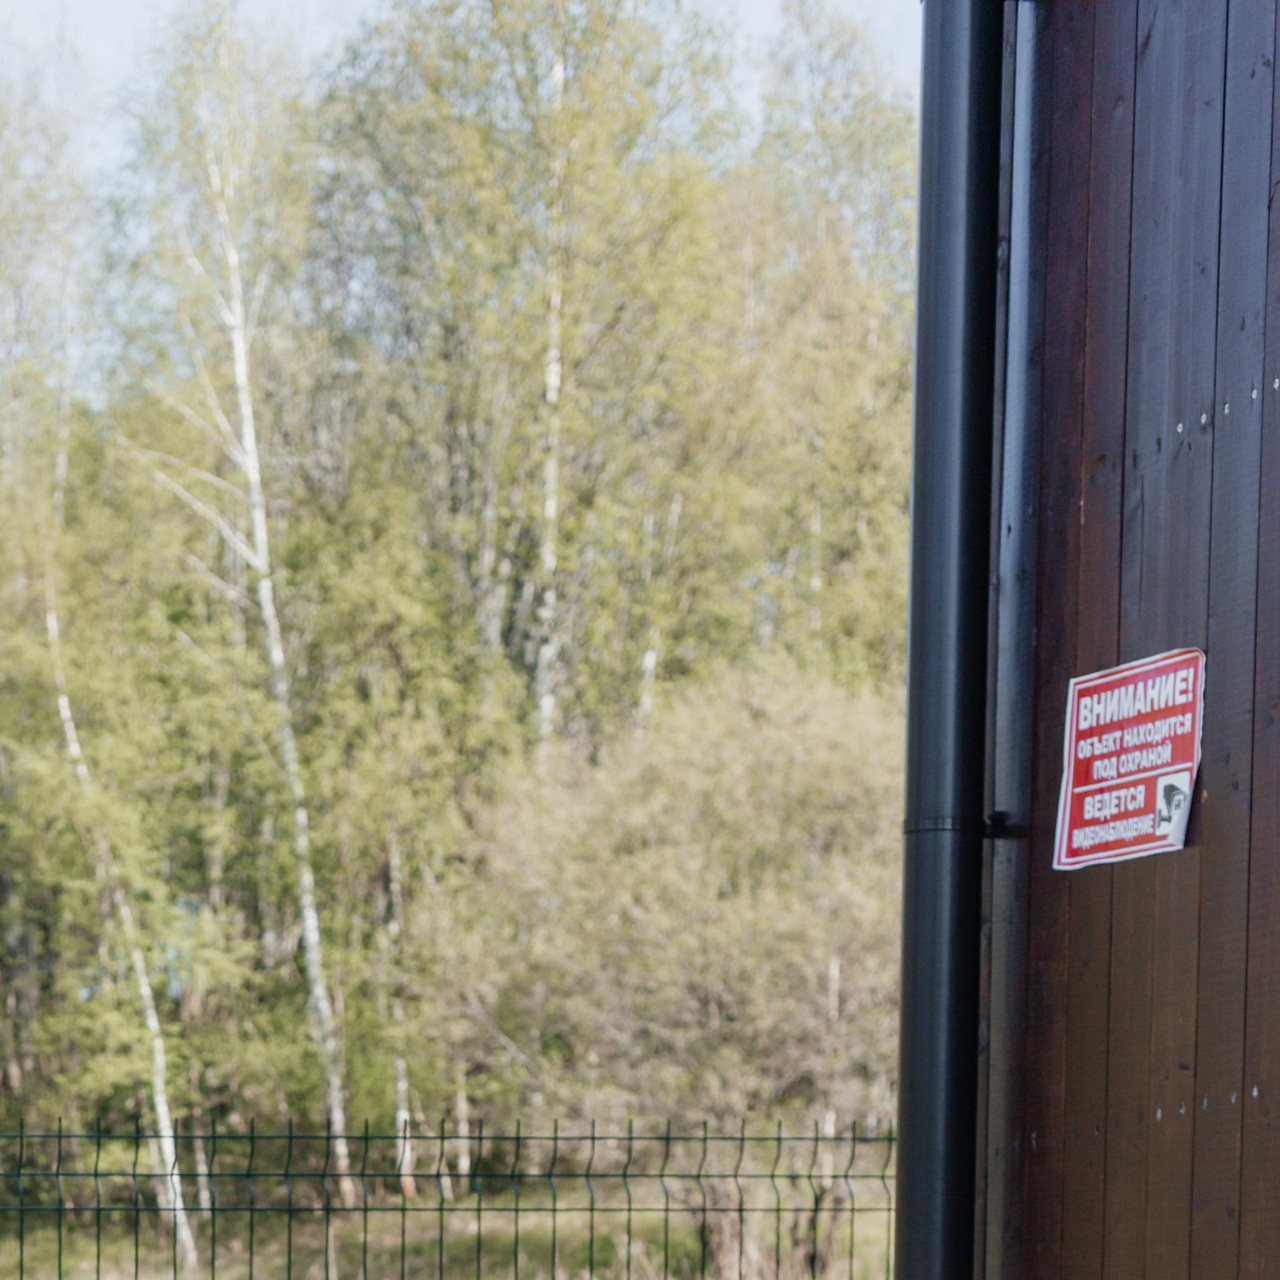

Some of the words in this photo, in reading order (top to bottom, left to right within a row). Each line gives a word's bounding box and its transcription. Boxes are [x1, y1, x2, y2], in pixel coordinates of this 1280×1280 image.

[1078, 668, 1194, 730] ВНИМАНИЕ!
[1078, 730, 1122, 759] ОБЪЕКТ
[1123, 713, 1192, 749] НАХОДИТСЯ
[1093, 758, 1117, 780] ПОД
[1120, 741, 1171, 774] ОХРАНОЙ
[1084, 785, 1145, 820] ВЕДЕТСЯ
